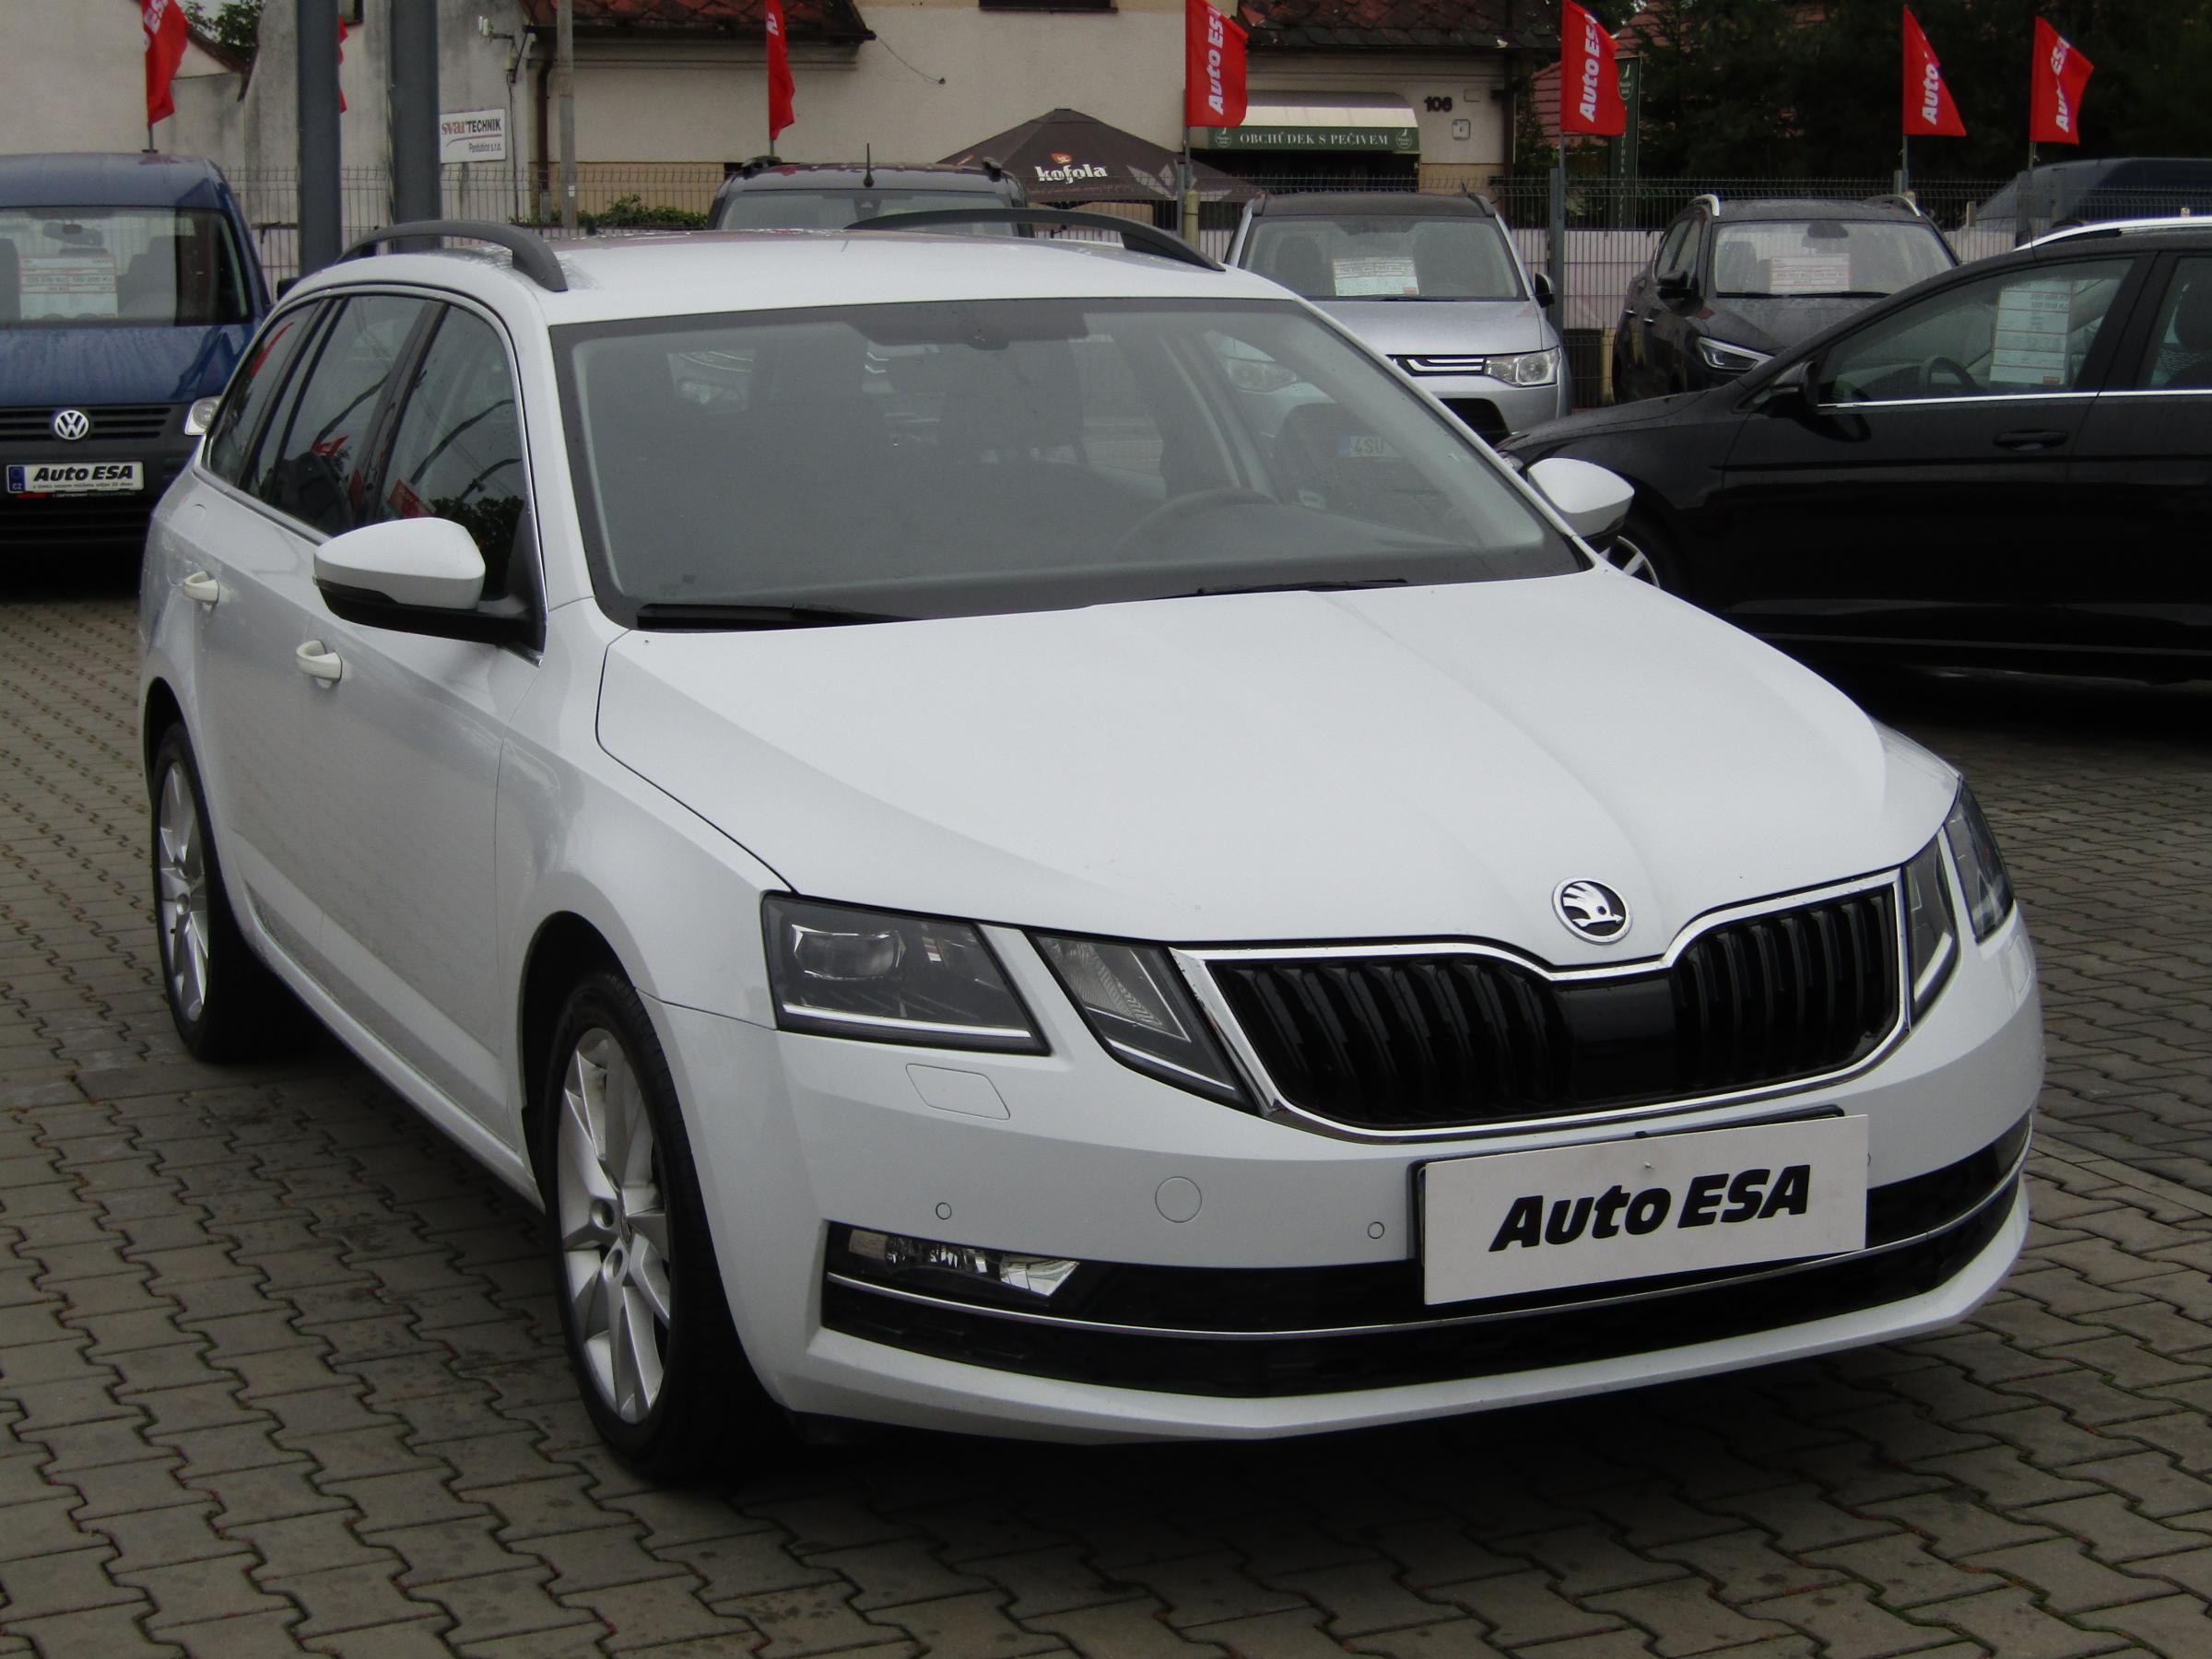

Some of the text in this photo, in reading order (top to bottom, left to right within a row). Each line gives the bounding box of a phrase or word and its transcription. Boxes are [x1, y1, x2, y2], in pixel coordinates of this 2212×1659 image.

[1206, 49, 1224, 115] Auto
[1579, 59, 1600, 123] Auto
[1319, 134, 1327, 145] S
[1330, 132, 1389, 146] PEČIVEM
[1034, 164, 1108, 184] kofola
[33, 465, 134, 482] Auto ESA
[1488, 1164, 1811, 1252] Auto ESA
